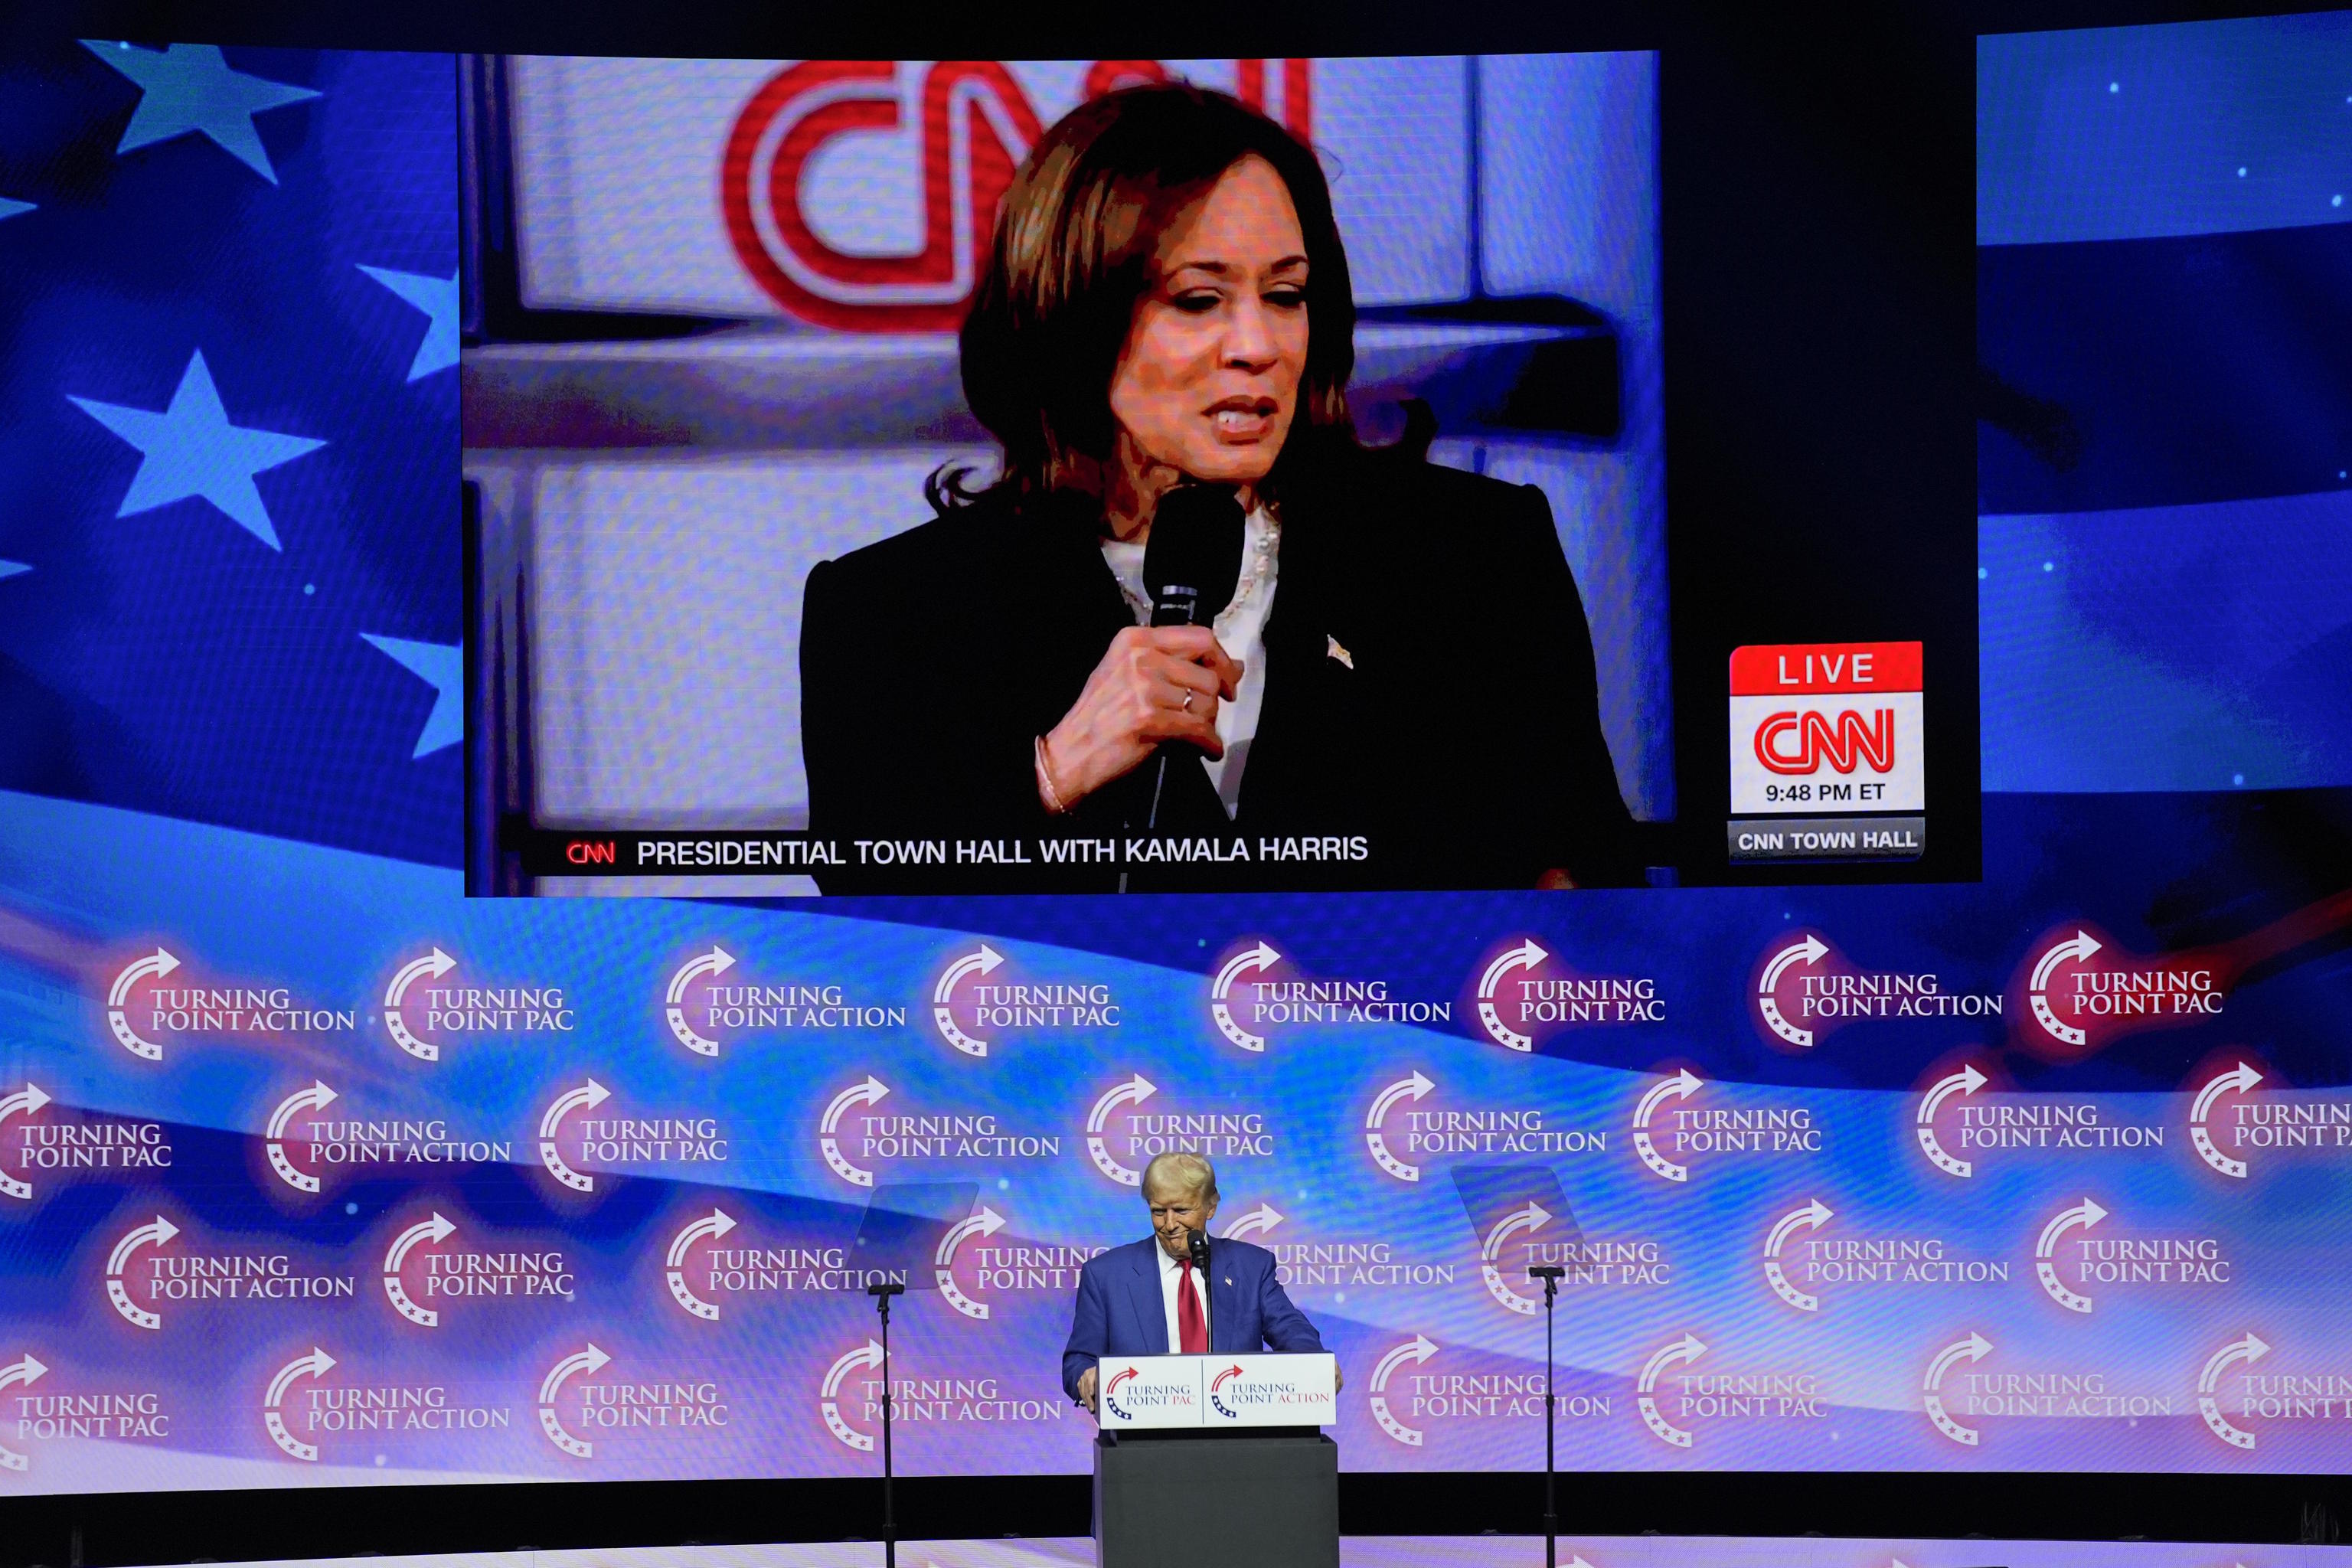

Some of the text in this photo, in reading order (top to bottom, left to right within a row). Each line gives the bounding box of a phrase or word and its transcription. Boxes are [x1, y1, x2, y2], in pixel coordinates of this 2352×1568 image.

[1779, 654, 1873, 684] LIVE
[1754, 709, 1894, 776] CNN
[1766, 783, 1886, 802] 9:48 PM ET
[566, 836, 1368, 864] CNN PRESIDENTIAL TOWN HALL WITH KAMALA HARRIS
[1738, 831, 1918, 851] CNN TOWN HALL
[1253, 982, 1387, 1001] TURNING
[1518, 979, 1654, 1000] TURNING
[1800, 975, 1937, 995] TURNING
[2071, 971, 2211, 992] TURNING
[150, 989, 289, 1009] TURNING
[426, 989, 563, 1008] TURNING
[707, 986, 841, 1006] TURNING
[974, 985, 1109, 1004] TURNING
[2074, 992, 2222, 1014] POINT PAC
[1255, 1002, 1450, 1022] POINT ACTION
[1521, 1001, 1664, 1021] POINT PAC
[1803, 995, 2002, 1016] POINT ACTION
[153, 1011, 354, 1031] POINT ACTION
[428, 1010, 573, 1031] POINT PAC
[709, 1008, 905, 1027] POINT ACTION
[977, 1006, 1119, 1027] POINT PAC
[1127, 1114, 1262, 1134] TURNING
[1406, 1111, 1541, 1131] TURNING
[1673, 1109, 1810, 1129] TURNING
[1958, 1106, 2097, 1126] TURNING
[2232, 1104, 2352, 1125] TURNIN
[19, 1124, 161, 1145] TURNING
[308, 1121, 446, 1142] TURNING
[580, 1119, 716, 1139] TURNING
[861, 1116, 996, 1136] TURNING
[2235, 1126, 2328, 1146] POINT
[863, 1137, 1059, 1157] POINT ACTION
[1129, 1135, 1272, 1156] POINT PAC
[1410, 1132, 1606, 1152] POINT ACTION
[1676, 1130, 1821, 1151] POINT PAC
[1961, 1127, 2163, 1148] POINT ACTION
[21, 1146, 171, 1168] POINT PAC
[310, 1142, 510, 1162] POINT ACTION
[583, 1141, 727, 1161] POINT PAC
[707, 1249, 843, 1269] TURNING
[1521, 1243, 1658, 1263] TURNING
[1805, 1240, 1942, 1260] TURNING
[2077, 1240, 2218, 1259] TURNING
[149, 1256, 289, 1277] TURNING
[425, 1253, 563, 1274] TURNING
[1805, 1262, 2008, 1282] POINT ACTION
[2080, 1262, 2230, 1282] POINT PAC
[427, 1274, 574, 1295] POINT PAC
[710, 1270, 906, 1290] POINT ACTION
[978, 1269, 1067, 1289] POINT
[1275, 1265, 1455, 1285] OINT ACTION
[1622, 1264, 1670, 1285] PAC
[151, 1277, 354, 1298] POINT ACTION
[580, 1383, 717, 1405] TURNING
[1125, 1385, 1190, 1396] TURNING
[1230, 1383, 1295, 1393] TURNING
[1410, 1375, 1547, 1395] TURNING
[1678, 1376, 1815, 1396] TURNING
[1965, 1374, 2104, 1395] TURNING
[2240, 1375, 2352, 1396] TURNIN
[16, 1394, 158, 1416] TURNING
[306, 1387, 445, 1408] TURNING
[1127, 1395, 1196, 1406] POINT PAC
[1231, 1392, 1329, 1403] POINT ACTION
[1413, 1396, 1501, 1416] POINT
[1681, 1396, 1827, 1417] POINT PAC
[1967, 1396, 2171, 1416] POINT ACTION
[582, 1405, 727, 1426] POINT PAC
[960, 1401, 1061, 1420] ACTION
[2243, 1398, 2336, 1418] POINT
[19, 1416, 168, 1438] POINT PAC
[309, 1409, 509, 1430] POINT ACTION
